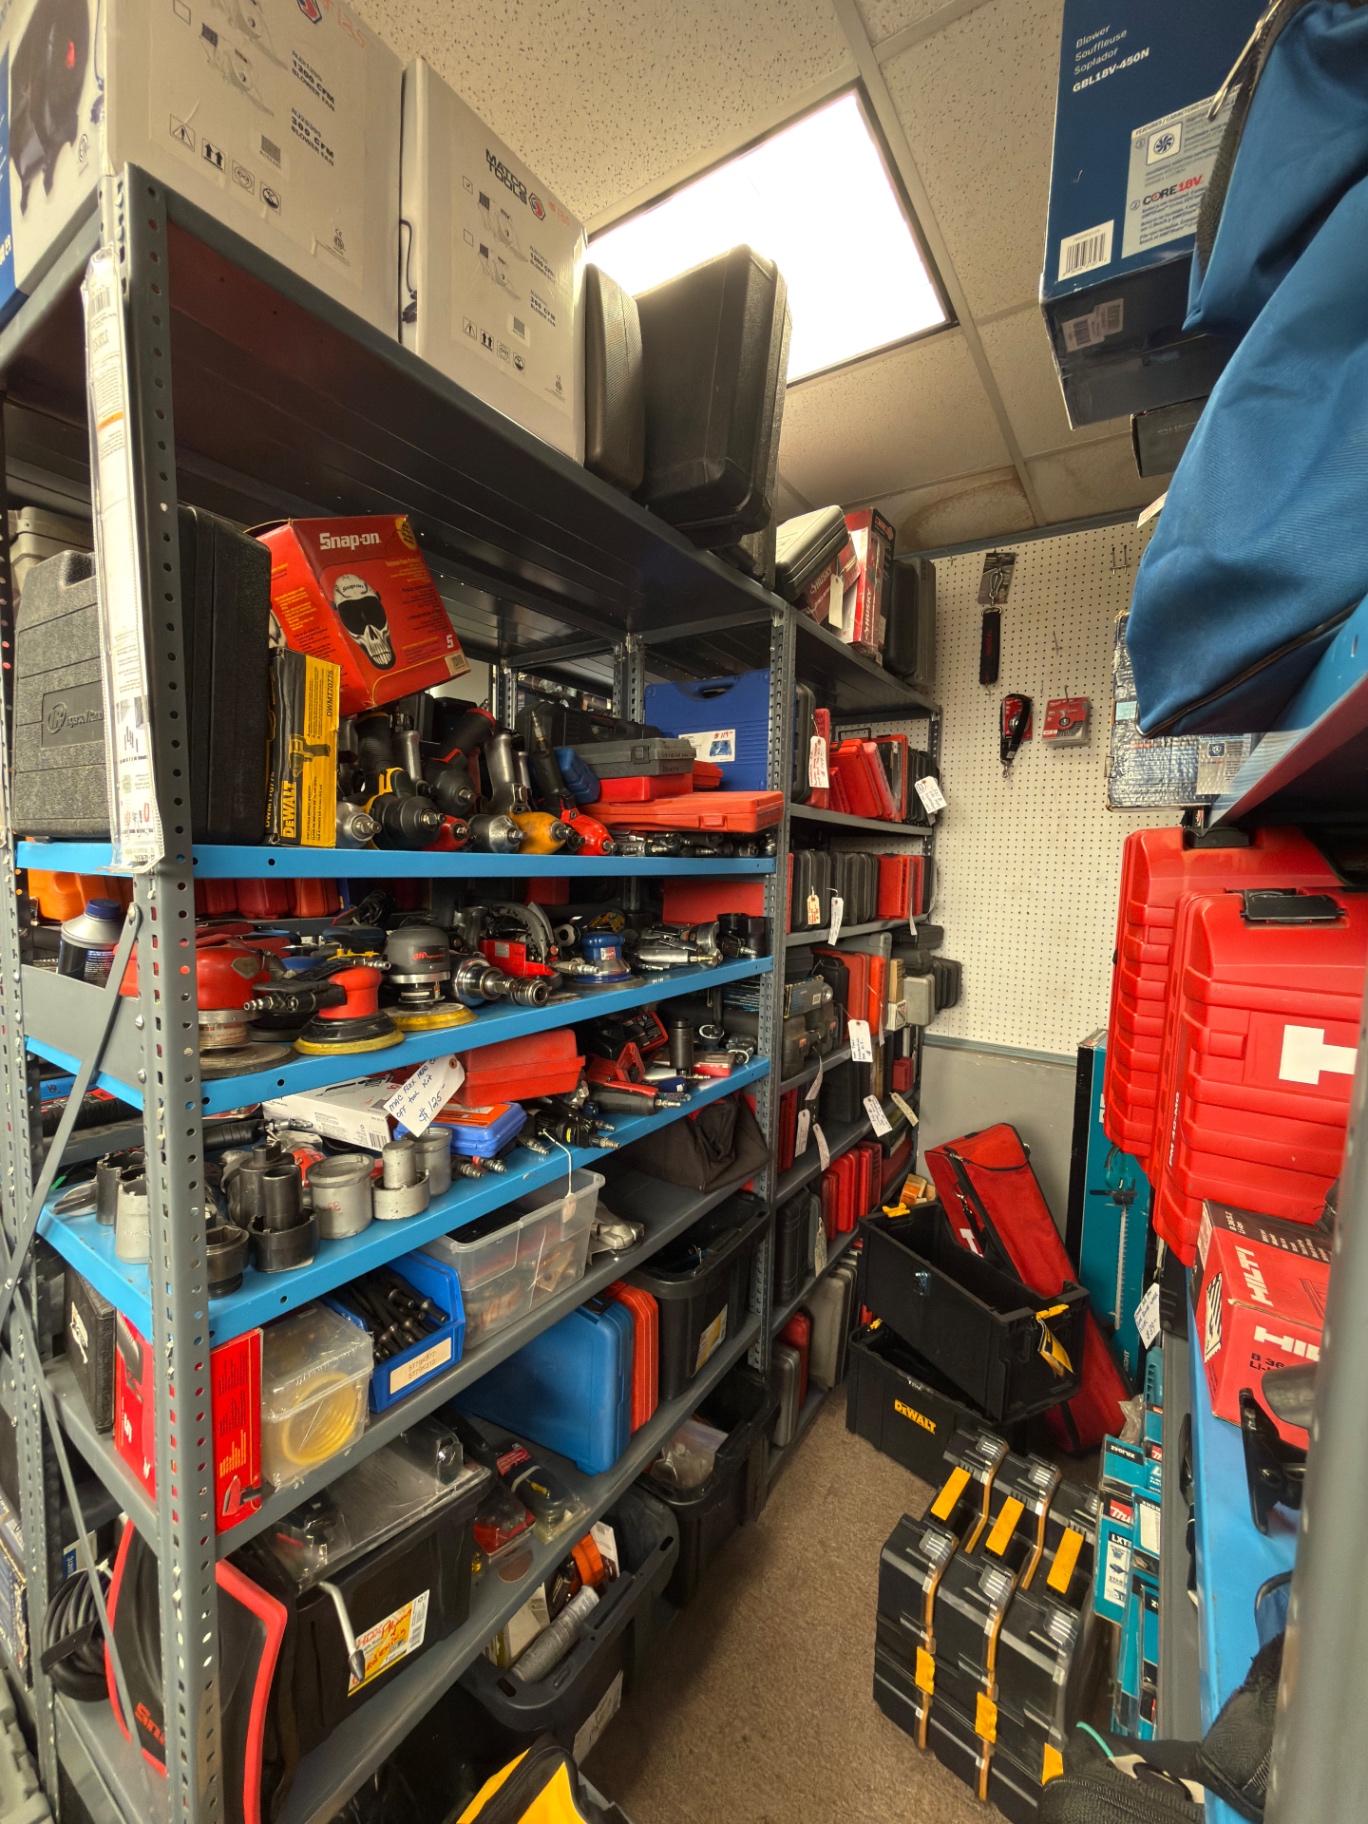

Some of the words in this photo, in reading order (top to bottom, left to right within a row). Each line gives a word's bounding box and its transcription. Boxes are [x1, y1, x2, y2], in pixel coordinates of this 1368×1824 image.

[1075, 24, 1111, 49] Blower
[1075, 29, 1127, 62] Souffleuse
[1072, 47, 1150, 92] GBL18V-450N
[1073, 47, 1118, 75] Soplador
[316, 83, 335, 104] CFM
[314, 136, 334, 159] CFM
[485, 148, 527, 195] MATCO
[488, 159, 527, 205] TOOLS
[319, 532, 380, 550] Snap-on
[388, 1095, 404, 1112] MAC
[1235, 1245, 1274, 1307] HILTI
[1251, 1353, 1262, 1362] B
